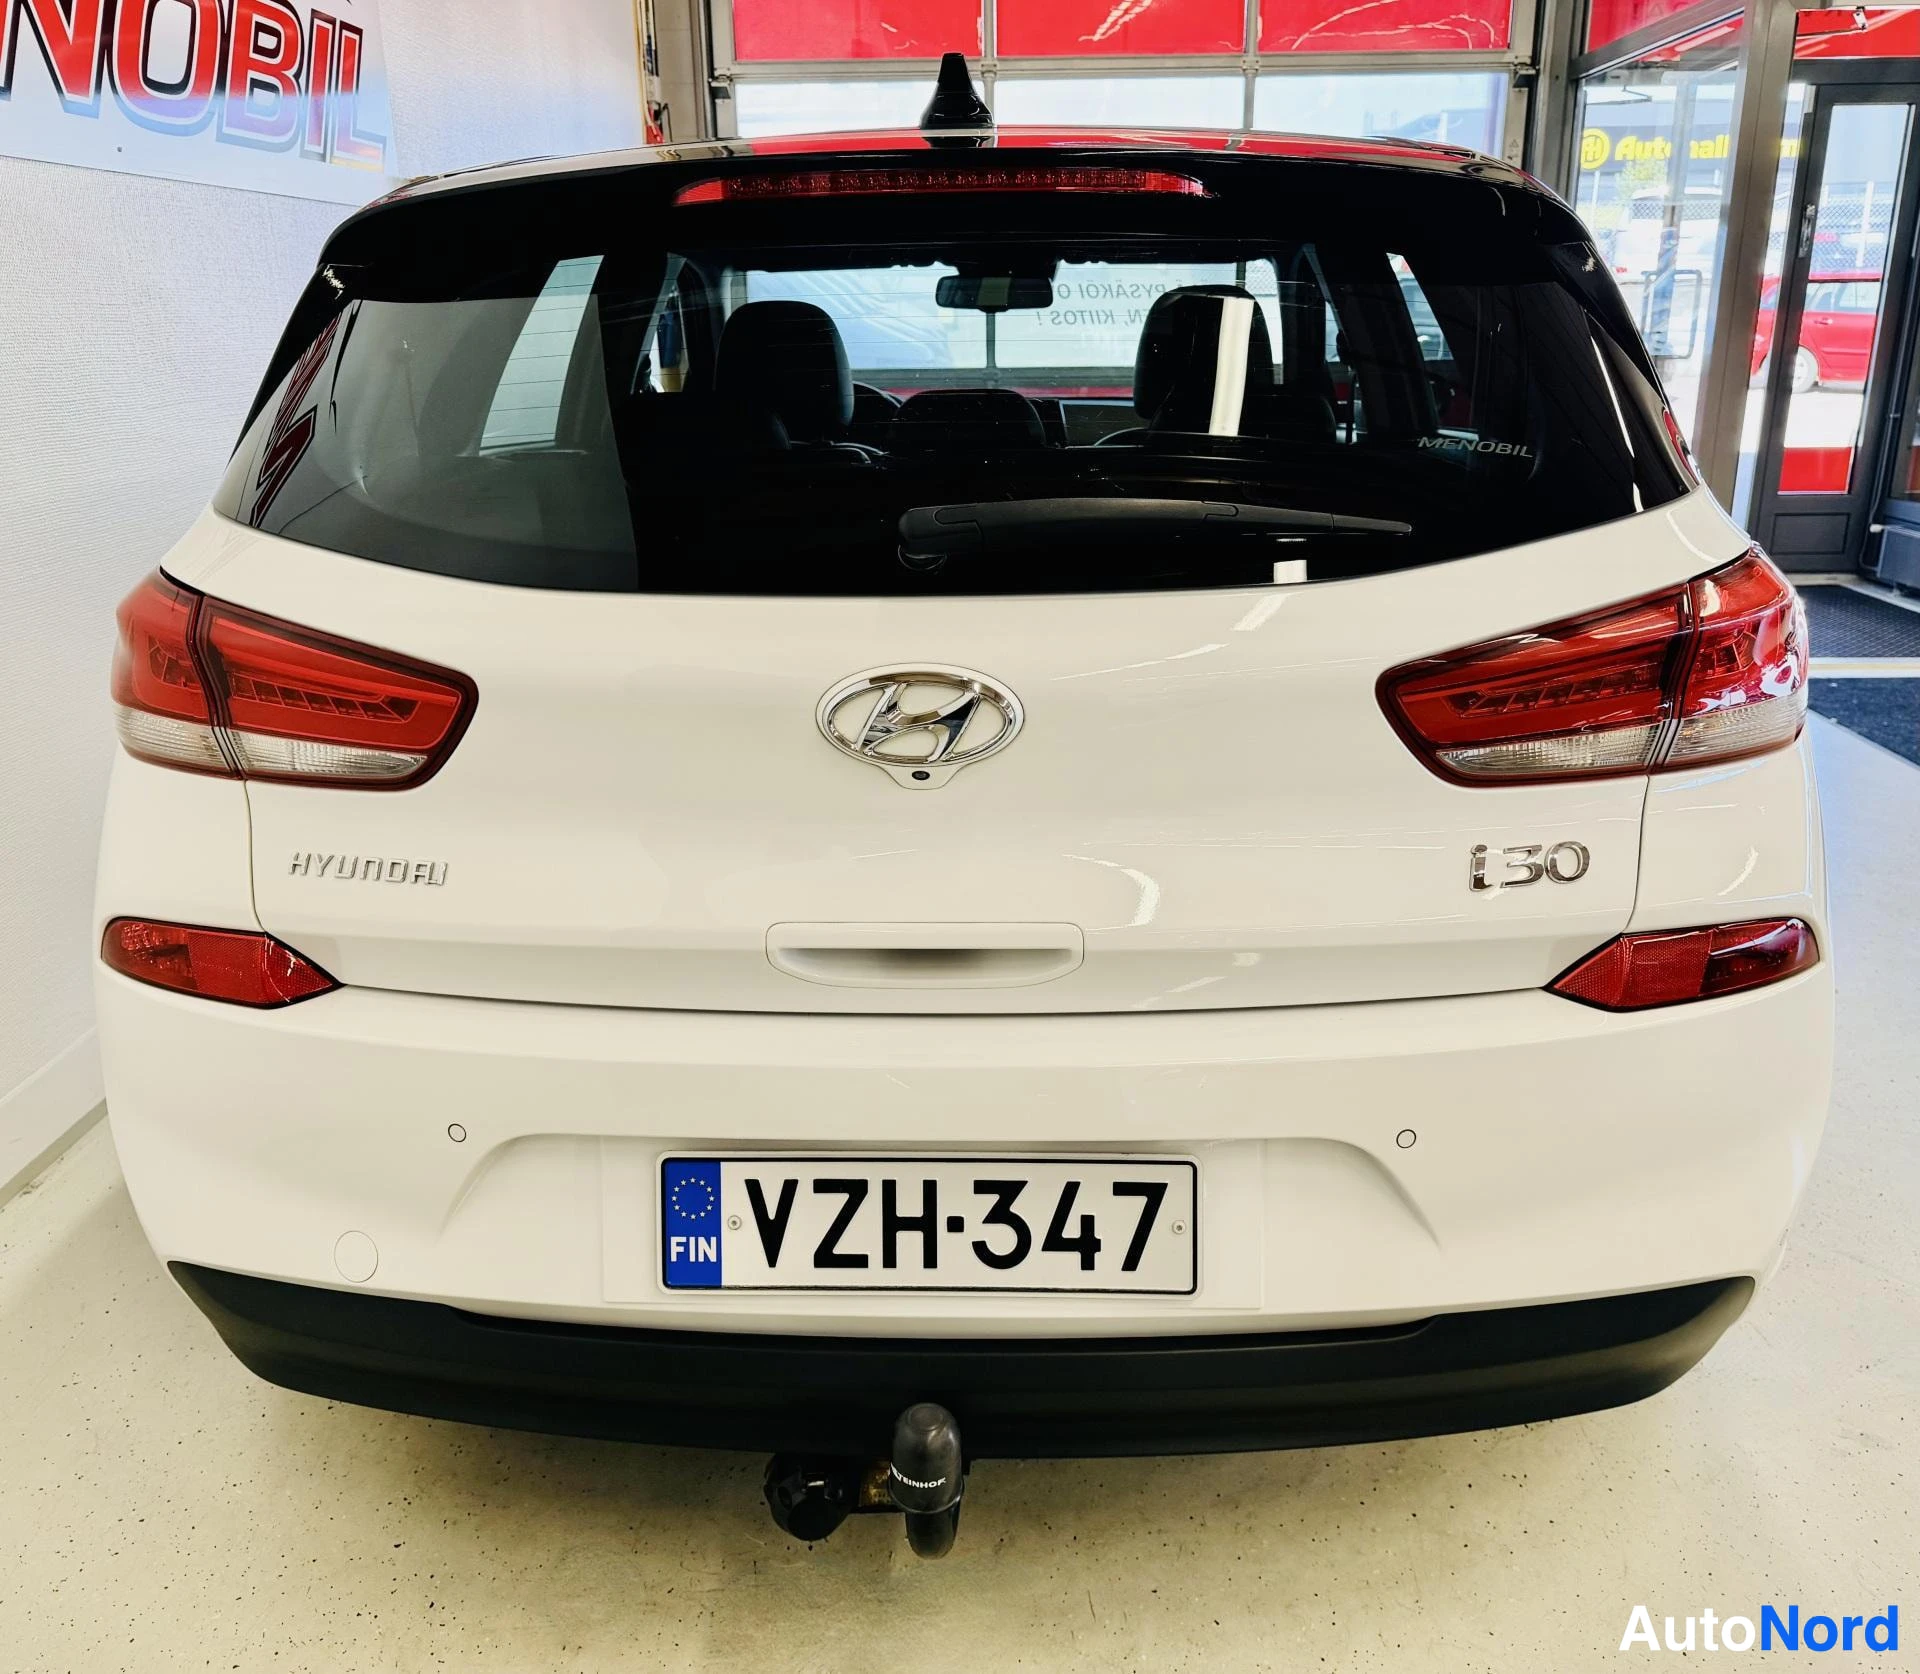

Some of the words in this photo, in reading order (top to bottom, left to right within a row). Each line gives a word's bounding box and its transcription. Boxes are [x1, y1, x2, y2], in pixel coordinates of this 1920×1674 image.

[1417, 436, 1534, 458] MENOBIL
[288, 852, 448, 886] HYUNDAI
[1469, 840, 1591, 892] i30
[670, 1236, 717, 1263] FIN
